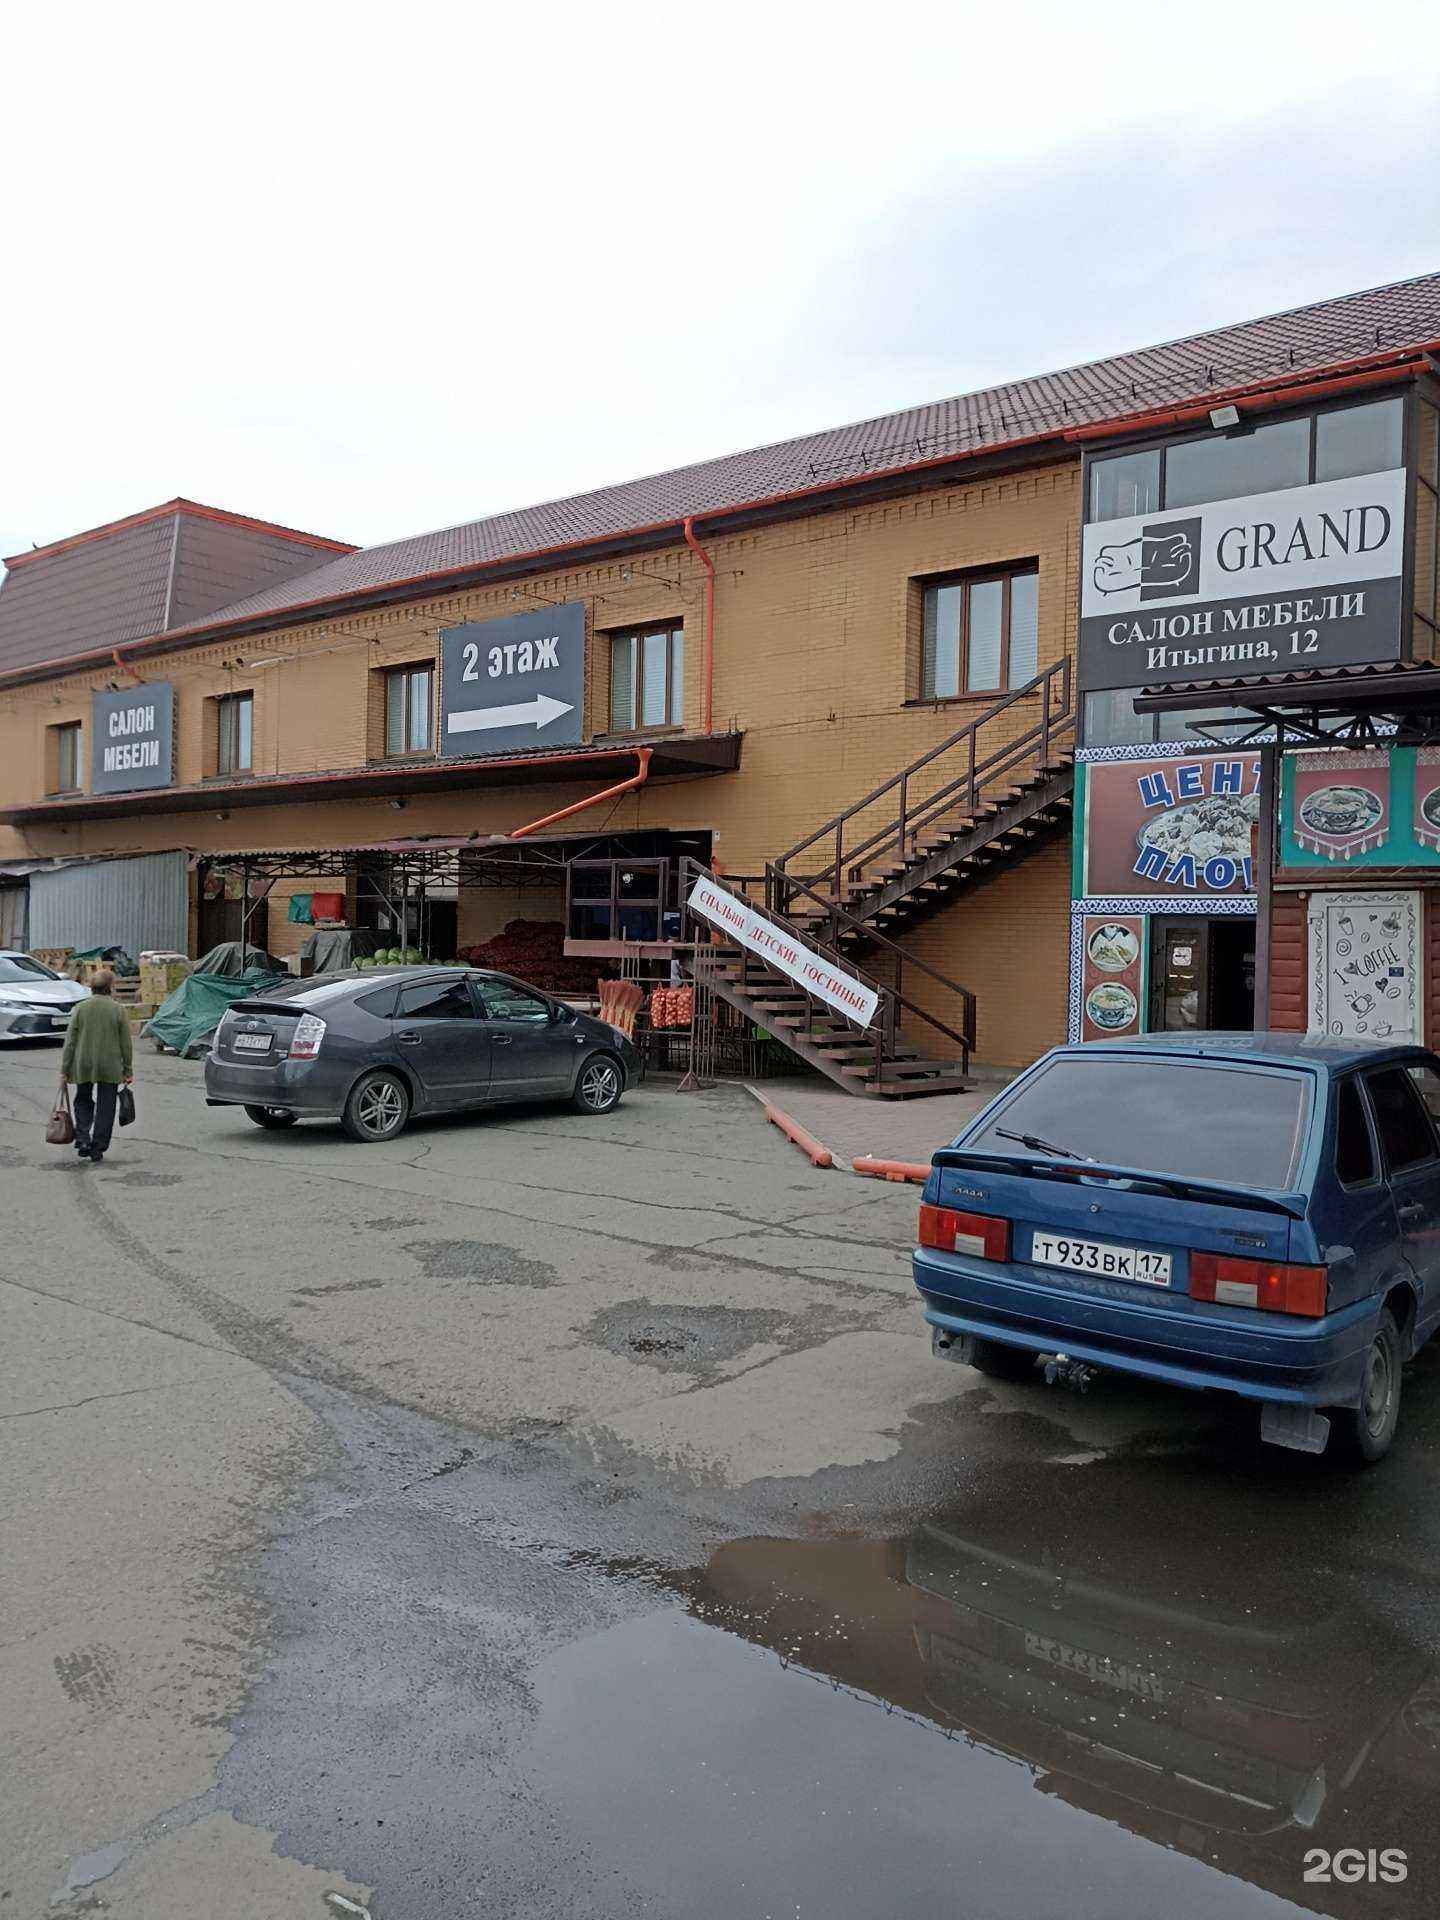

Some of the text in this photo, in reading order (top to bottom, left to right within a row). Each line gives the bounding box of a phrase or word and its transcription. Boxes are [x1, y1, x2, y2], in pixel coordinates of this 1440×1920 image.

[1216, 505, 1391, 573] GRAND
[1108, 592, 1367, 646] САЛОН МЕБЕЛИ
[462, 636, 560, 681] 2 этаж
[1145, 629, 1320, 670] Итыгина, 12
[108, 705, 155, 737] САЛОН
[103, 740, 159, 772] МЕБЕЛИ
[699, 889, 869, 1014] СПАЛЬНИ ДЕТСКИЕ ГОСТИНЫЕ
[1355, 942, 1401, 977] COFFEE
[1140, 1254, 1163, 1274] 17
